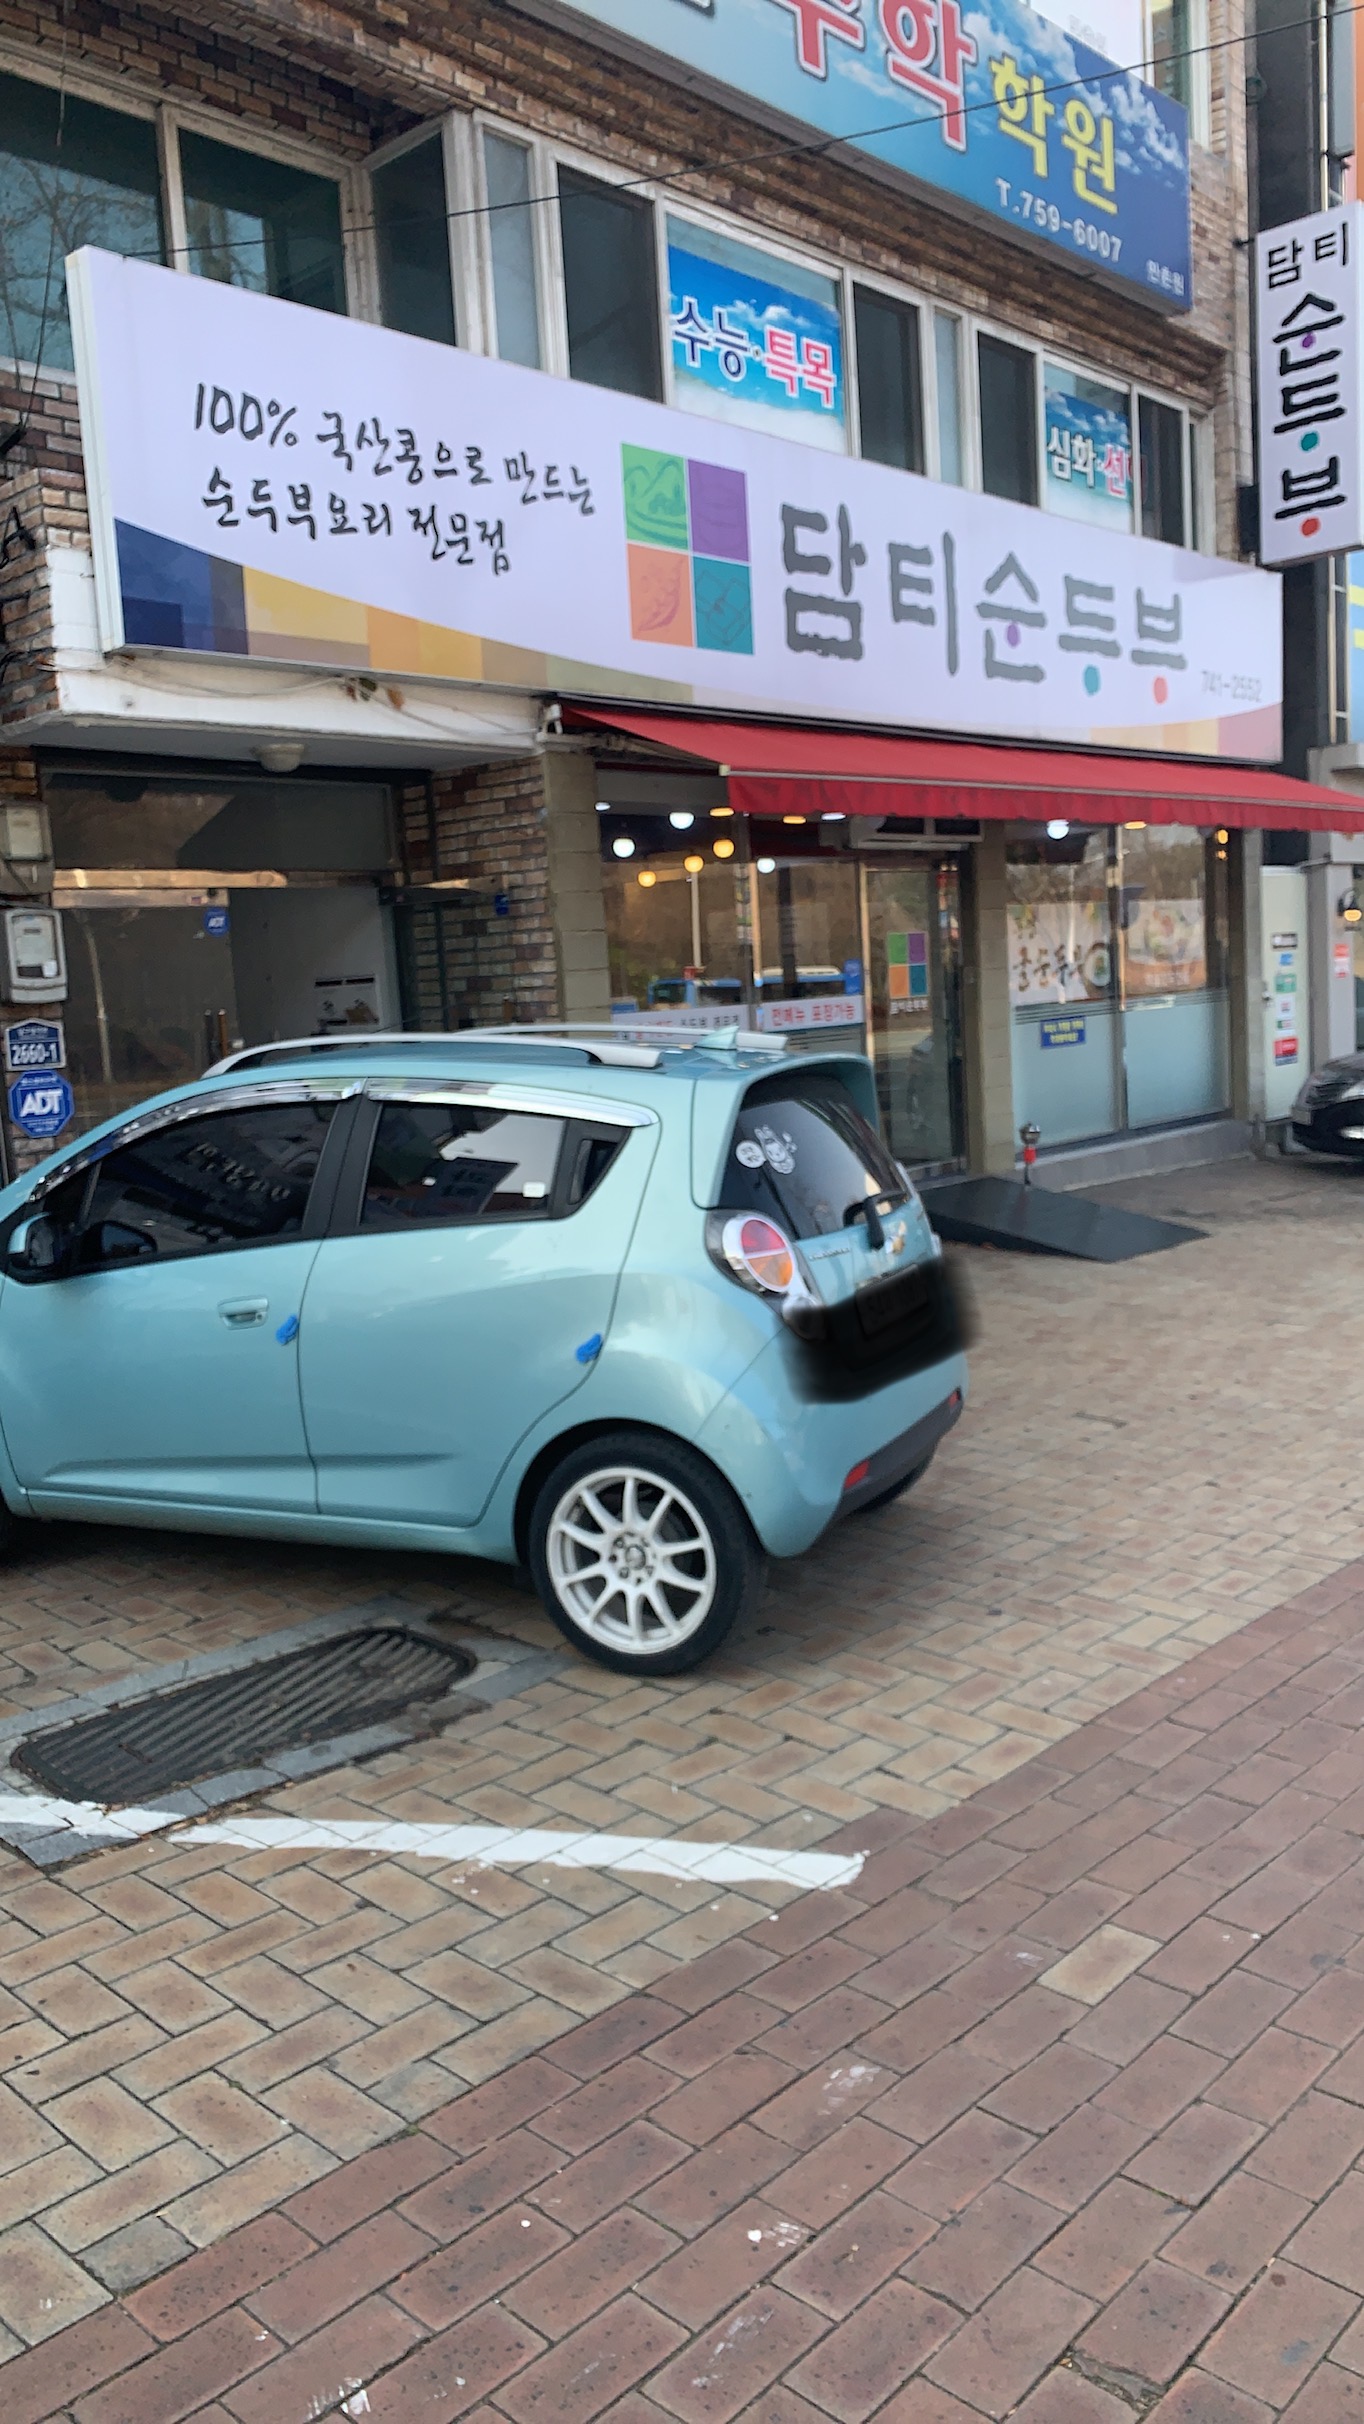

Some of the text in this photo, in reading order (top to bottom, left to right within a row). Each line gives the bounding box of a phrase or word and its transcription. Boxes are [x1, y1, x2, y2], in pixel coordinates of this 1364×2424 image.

[987, 52, 1119, 216] 학원
[995, 177, 1123, 262] T.759-6007
[1267, 222, 1349, 290] 담티
[195, 381, 595, 516] 100% 국산콩으로 만드는
[1272, 292, 1347, 538] 순두부
[1046, 425, 1134, 498] 심화·선
[406, 504, 511, 576] 전문점
[208, 916, 225, 927] ADT
[20, 1089, 64, 1118] ADT
